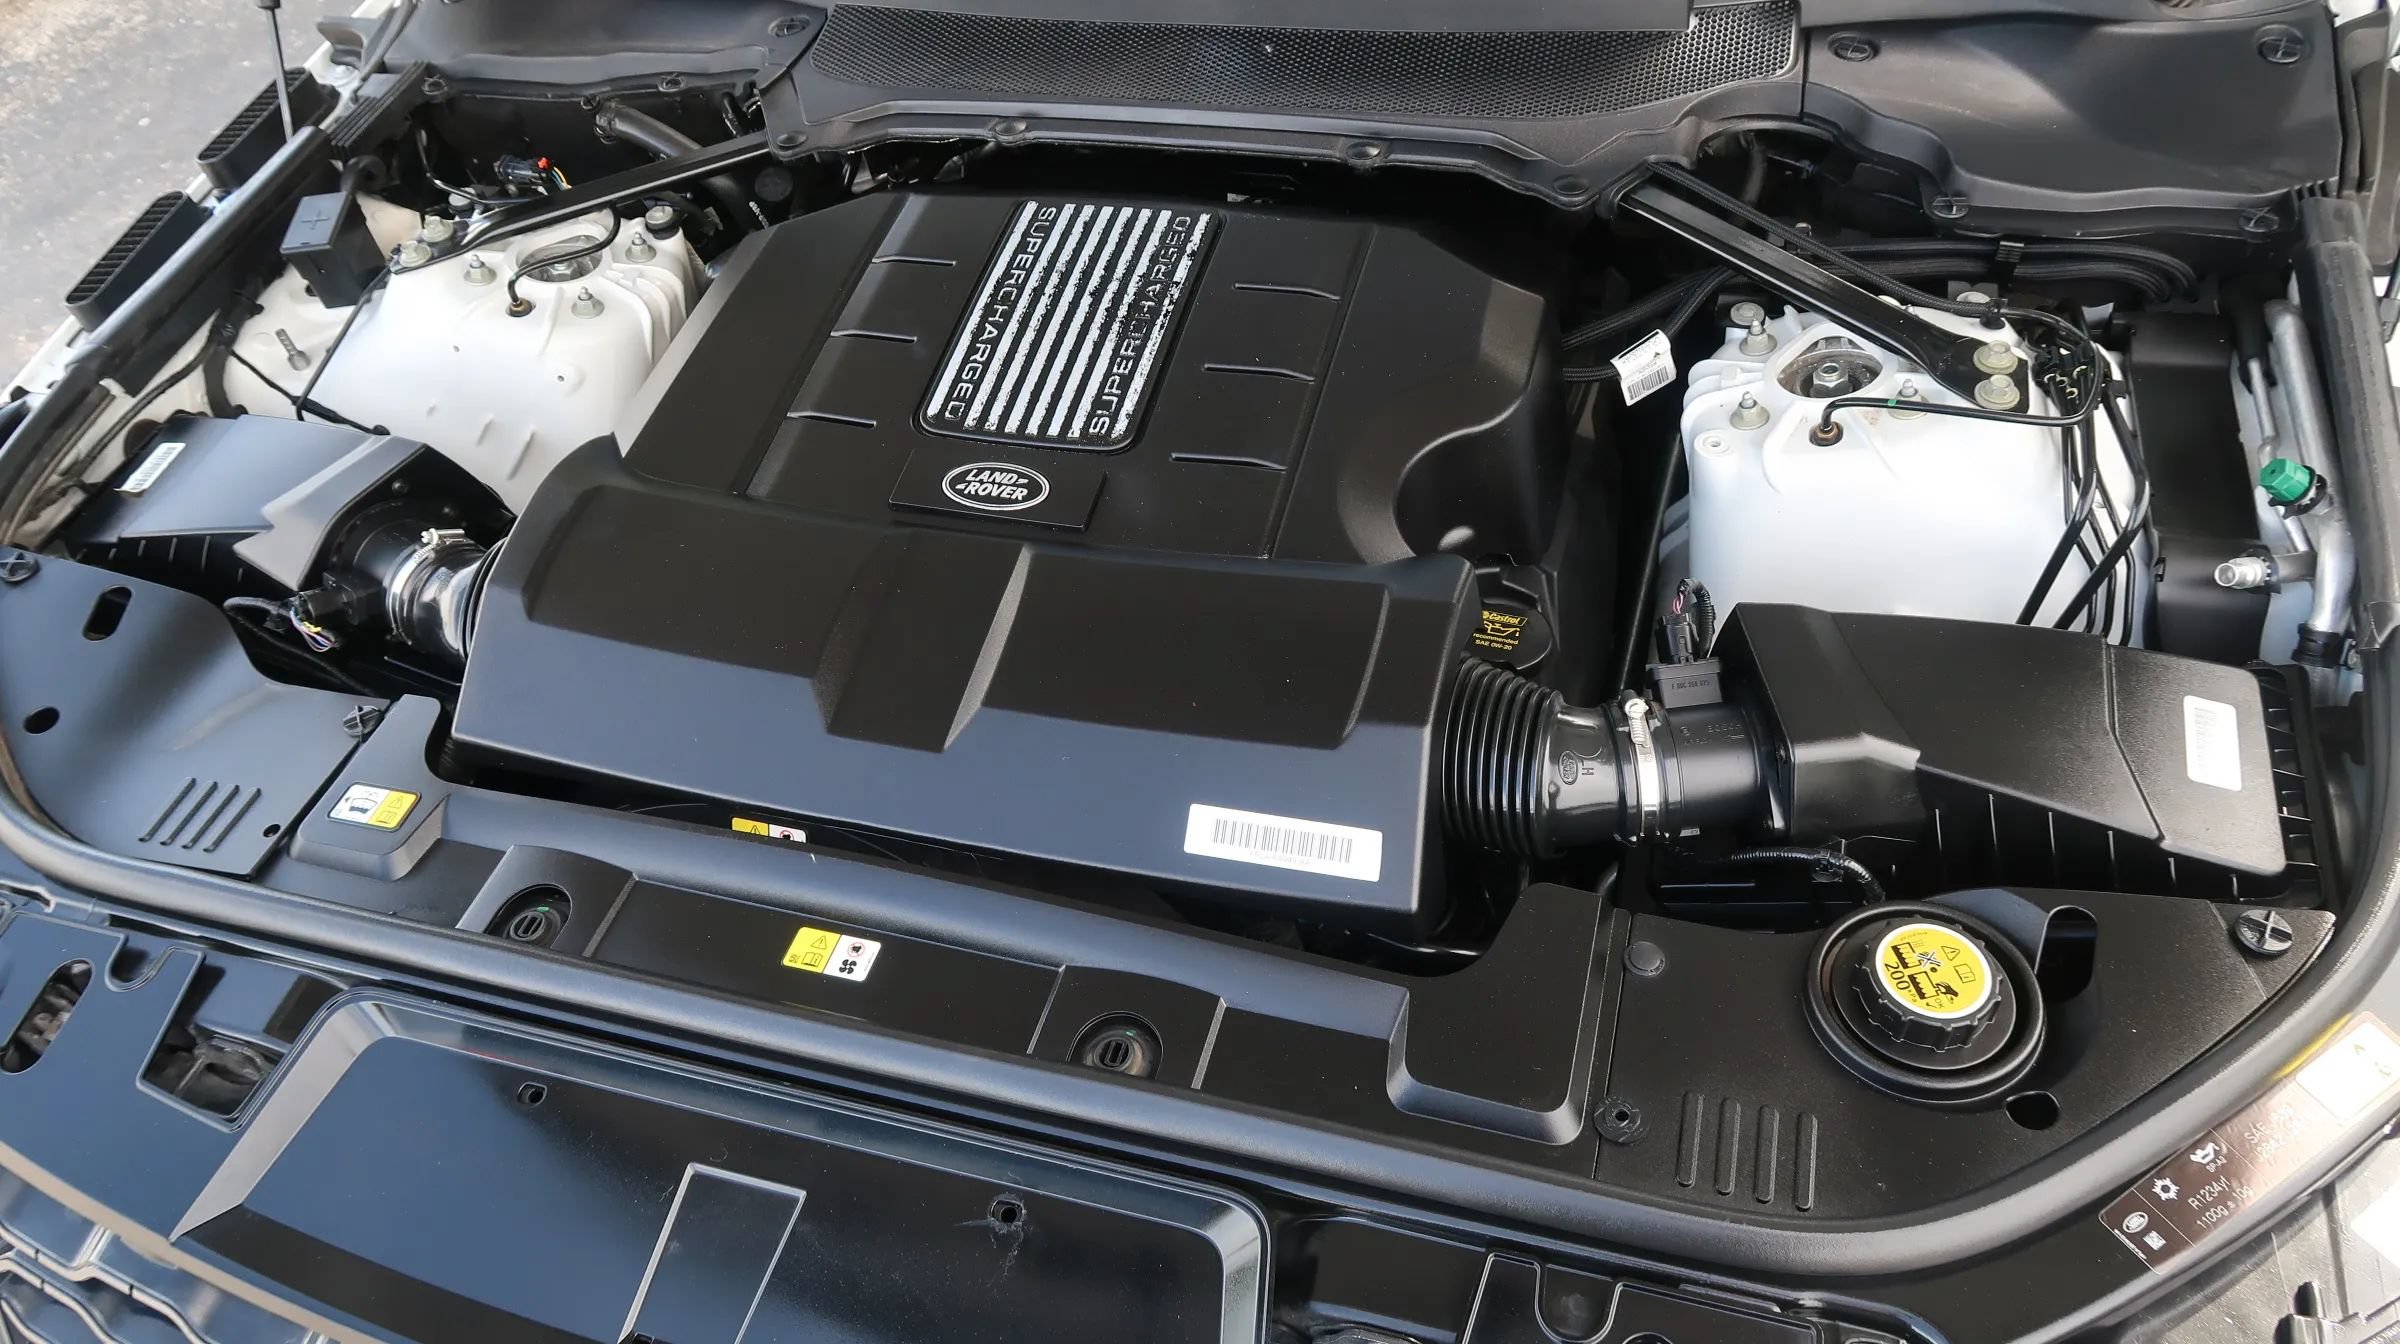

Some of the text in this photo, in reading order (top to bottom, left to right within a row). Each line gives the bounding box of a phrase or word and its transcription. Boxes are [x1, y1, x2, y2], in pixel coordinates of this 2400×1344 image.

[944, 206, 1057, 421] SUPERCHARGED
[1089, 215, 1191, 435] SUPERCHARGED
[965, 468, 1018, 485] LAND
[964, 482, 1028, 501] ROVER
[1489, 613, 1520, 624] Castrol
[1473, 633, 1519, 645] recommended
[1884, 961, 1911, 990] 200
[2244, 1121, 2267, 1145] SAE
[2196, 1206, 2230, 1231] 1100g
[2234, 1184, 2255, 1203] 10g
